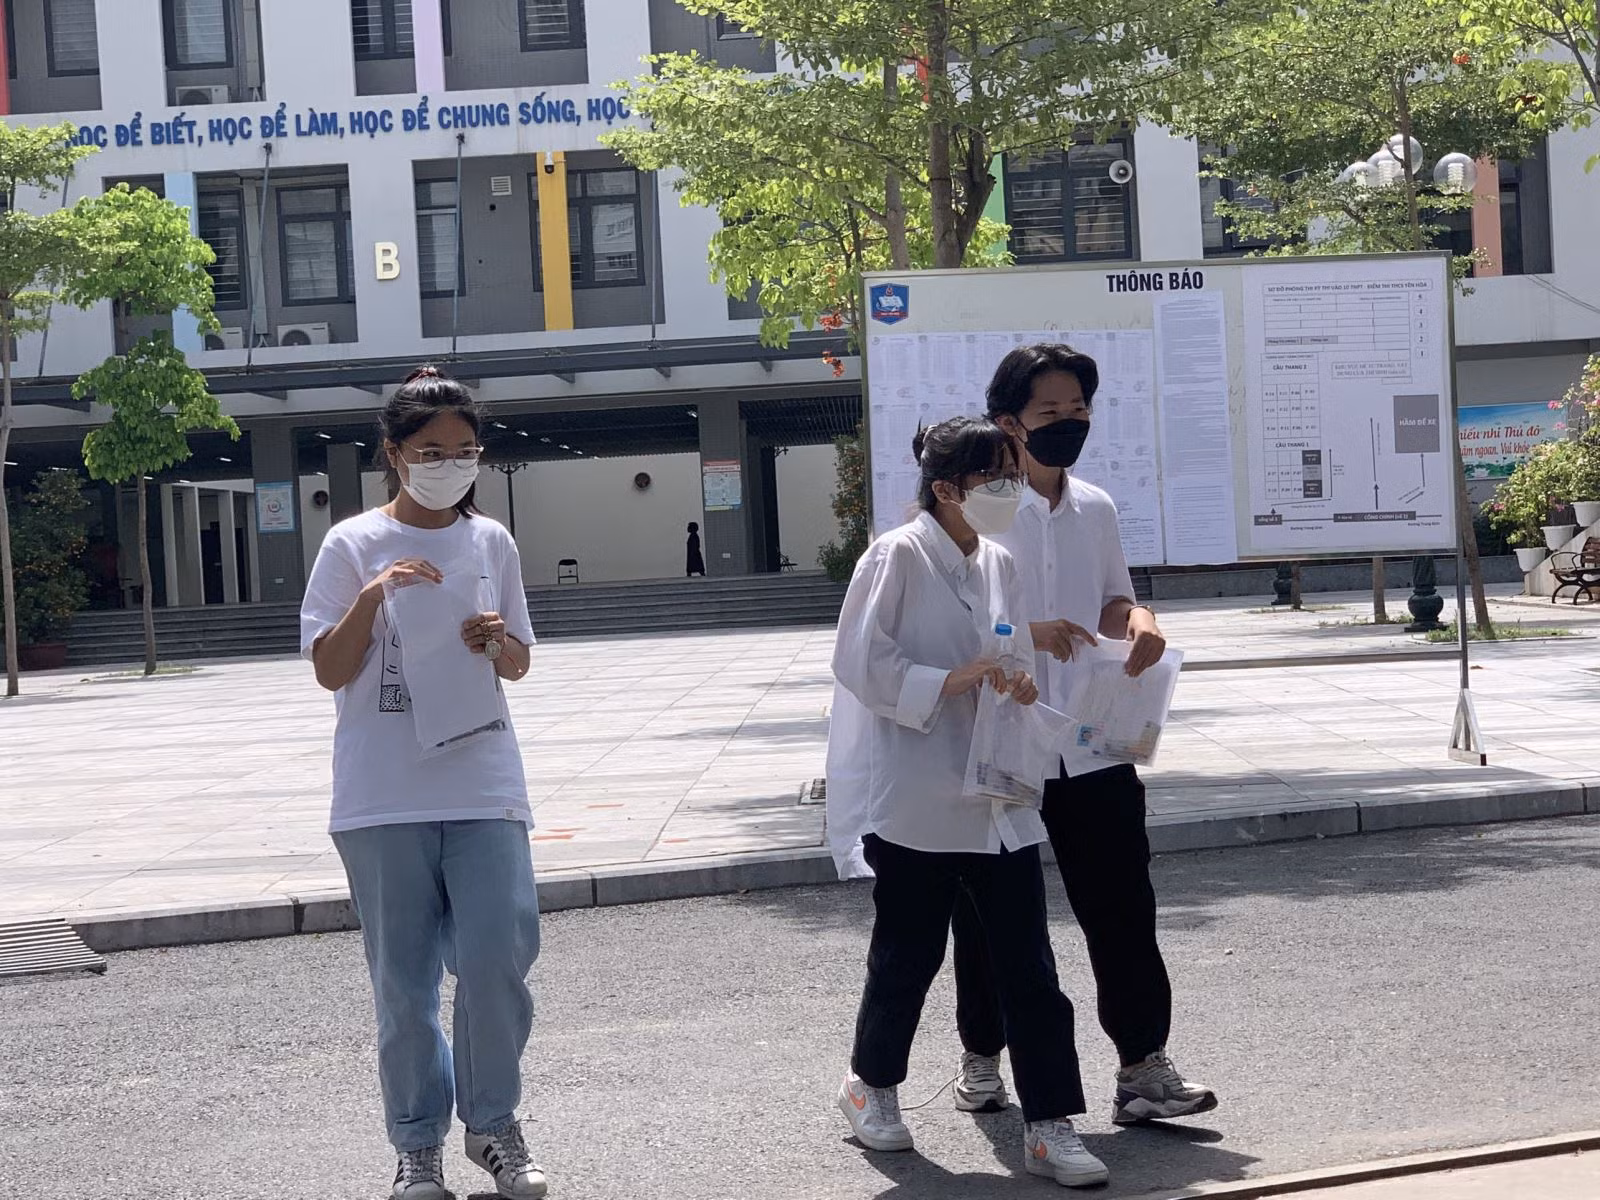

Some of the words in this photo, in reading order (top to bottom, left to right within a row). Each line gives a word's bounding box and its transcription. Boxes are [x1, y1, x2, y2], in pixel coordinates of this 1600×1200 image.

[115, 111, 143, 147] ĐỂ
[151, 112, 203, 147] BIẾT,
[209, 116, 252, 145] HỌC
[260, 102, 288, 138] ĐỂ
[296, 108, 345, 139] LÀM,
[350, 109, 393, 138] HỌC
[402, 95, 430, 131] ĐỂ
[438, 102, 510, 129] CHUNG
[518, 92, 581, 126] SỐNG,
[587, 97, 630, 125] HỌC
[375, 241, 401, 280] B
[1106, 270, 1164, 293] THÔNG
[1169, 267, 1204, 290] BÁO
